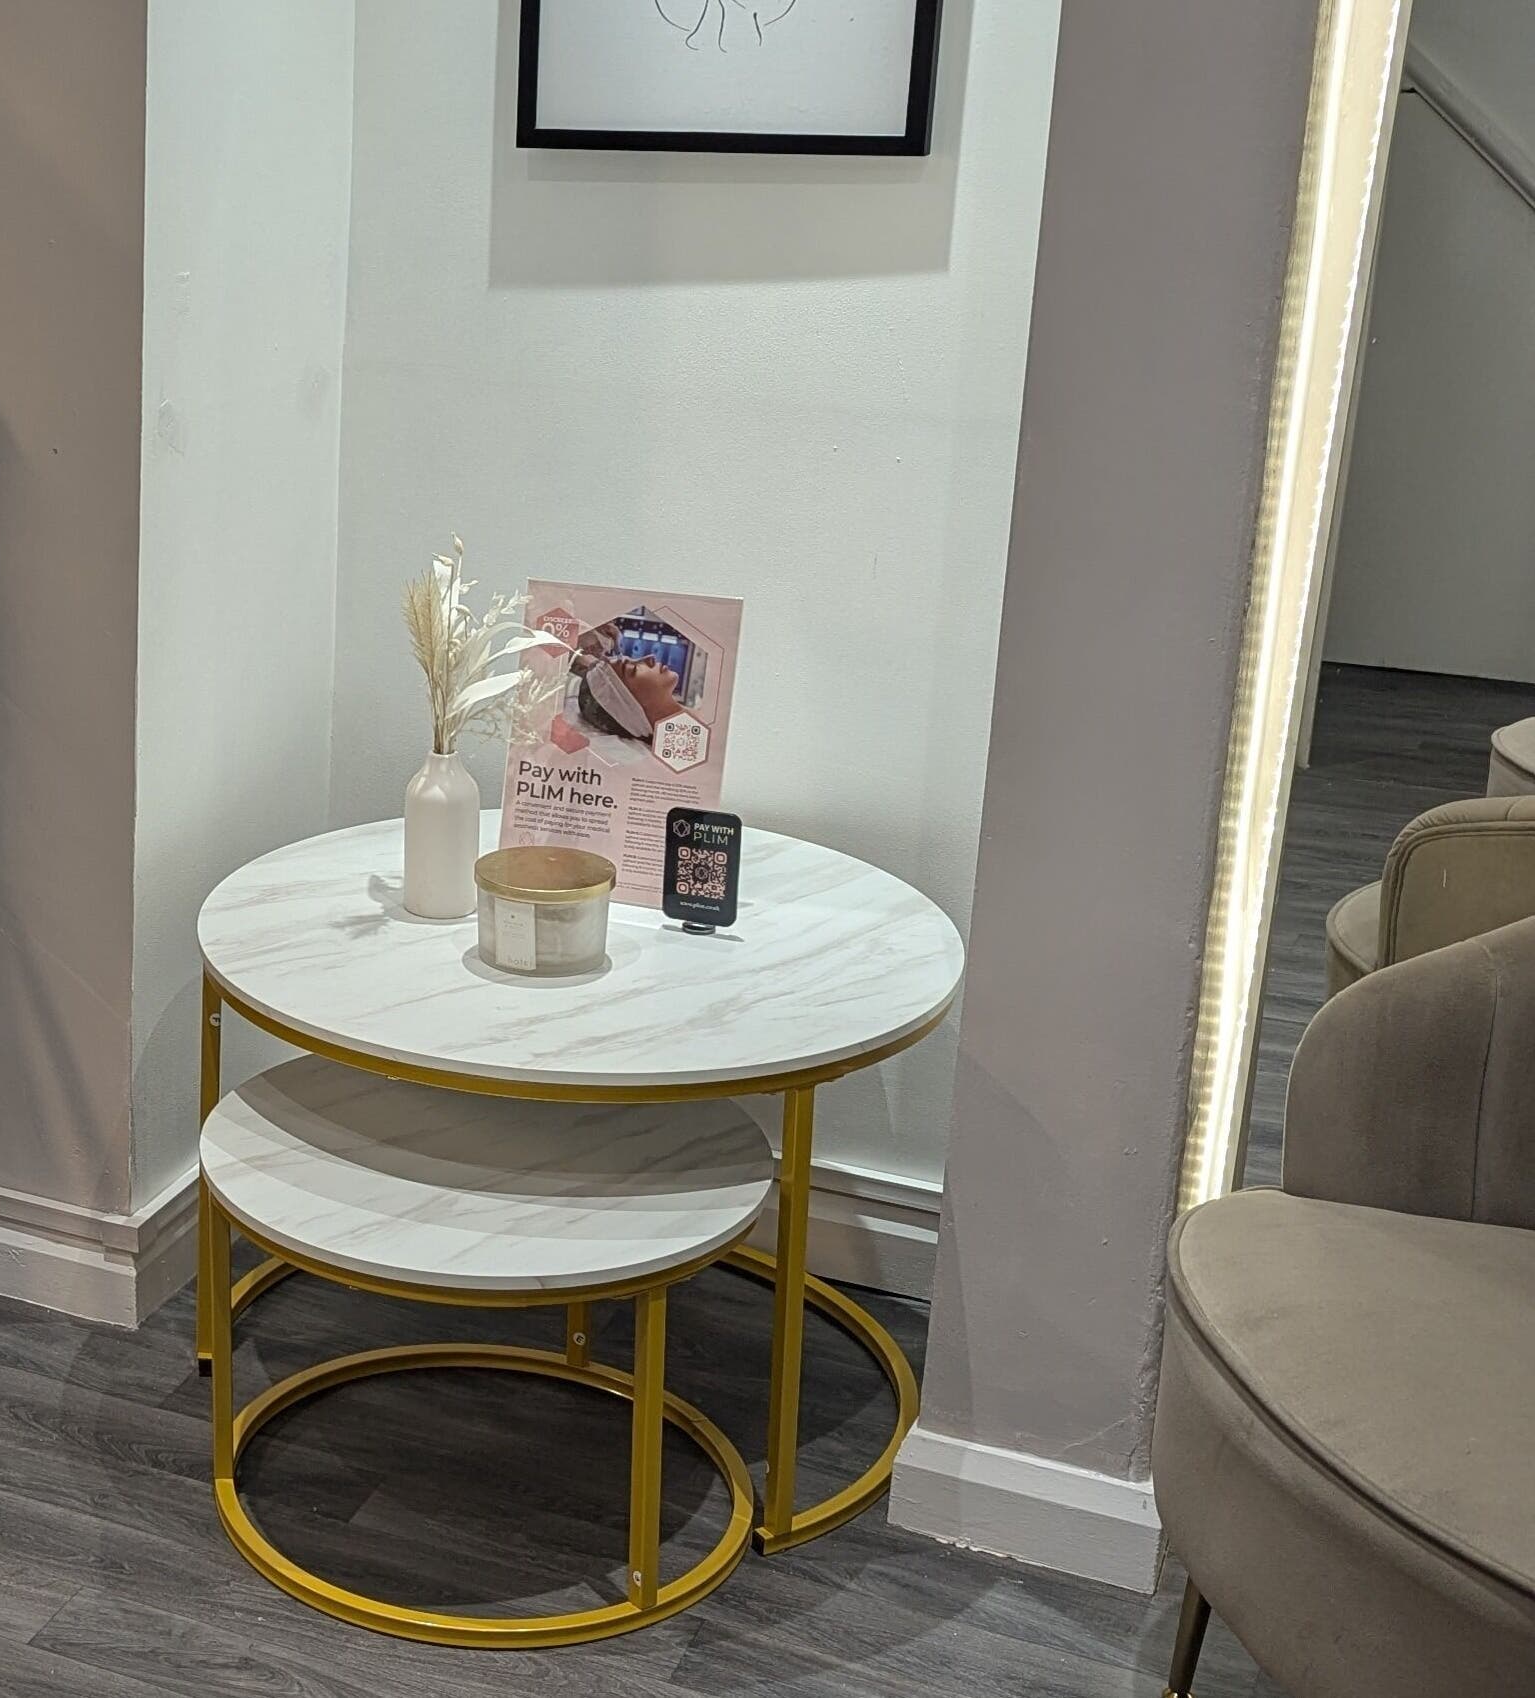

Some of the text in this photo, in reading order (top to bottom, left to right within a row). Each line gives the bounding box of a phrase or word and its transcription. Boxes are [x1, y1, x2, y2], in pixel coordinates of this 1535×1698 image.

[518, 760, 602, 786] Pay with
[516, 780, 564, 802] PLIM
[569, 787, 618, 809] here.
[693, 822, 735, 836] PAY WITH
[693, 831, 729, 846] PLIM
